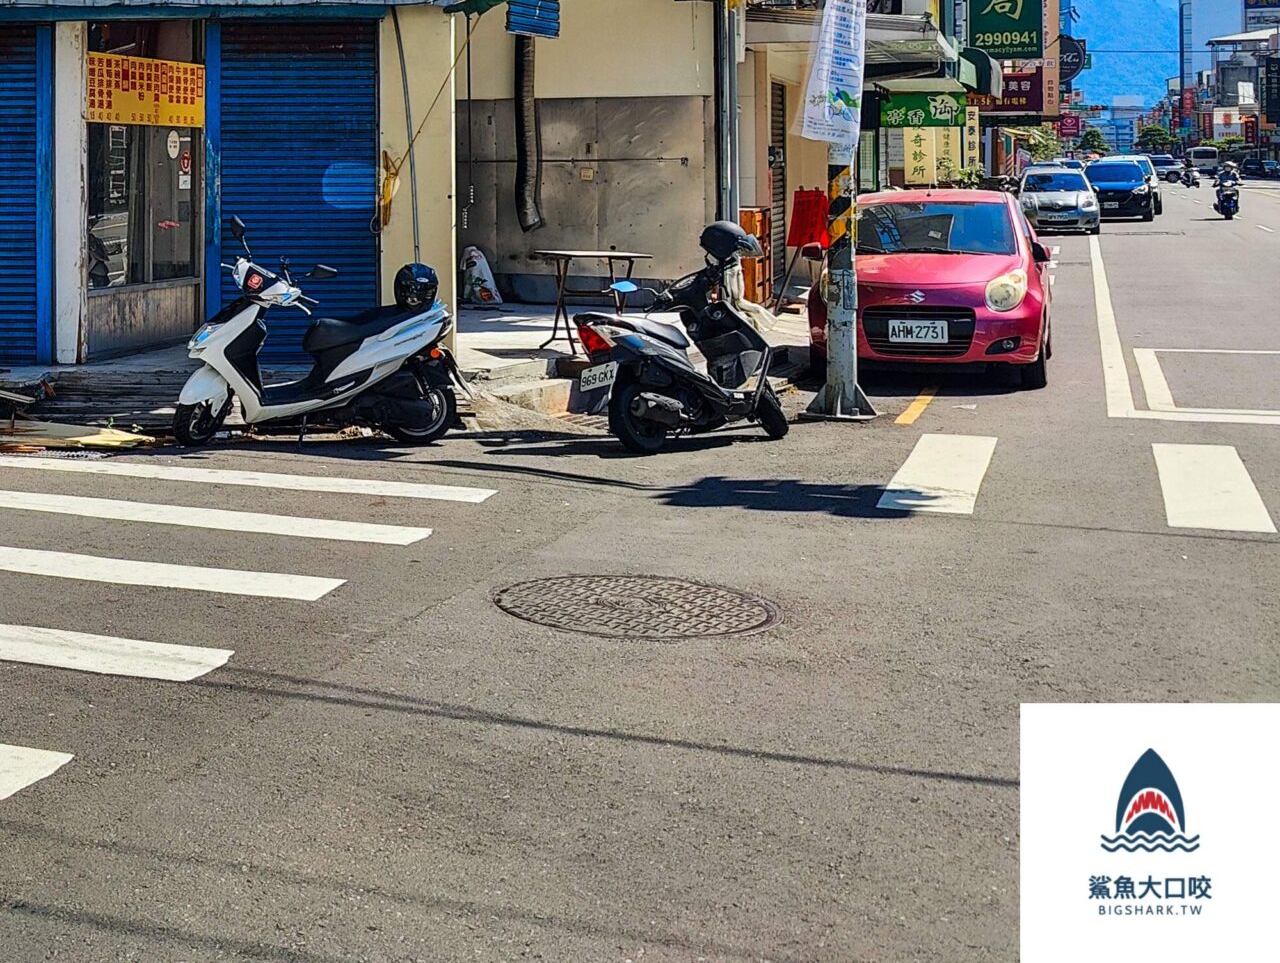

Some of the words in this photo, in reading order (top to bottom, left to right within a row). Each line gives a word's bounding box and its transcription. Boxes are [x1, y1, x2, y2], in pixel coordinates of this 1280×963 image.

[975, 31, 1037, 46] 2990941
[967, 111, 977, 167] 安泰診所
[890, 325, 944, 340] AHM-2731
